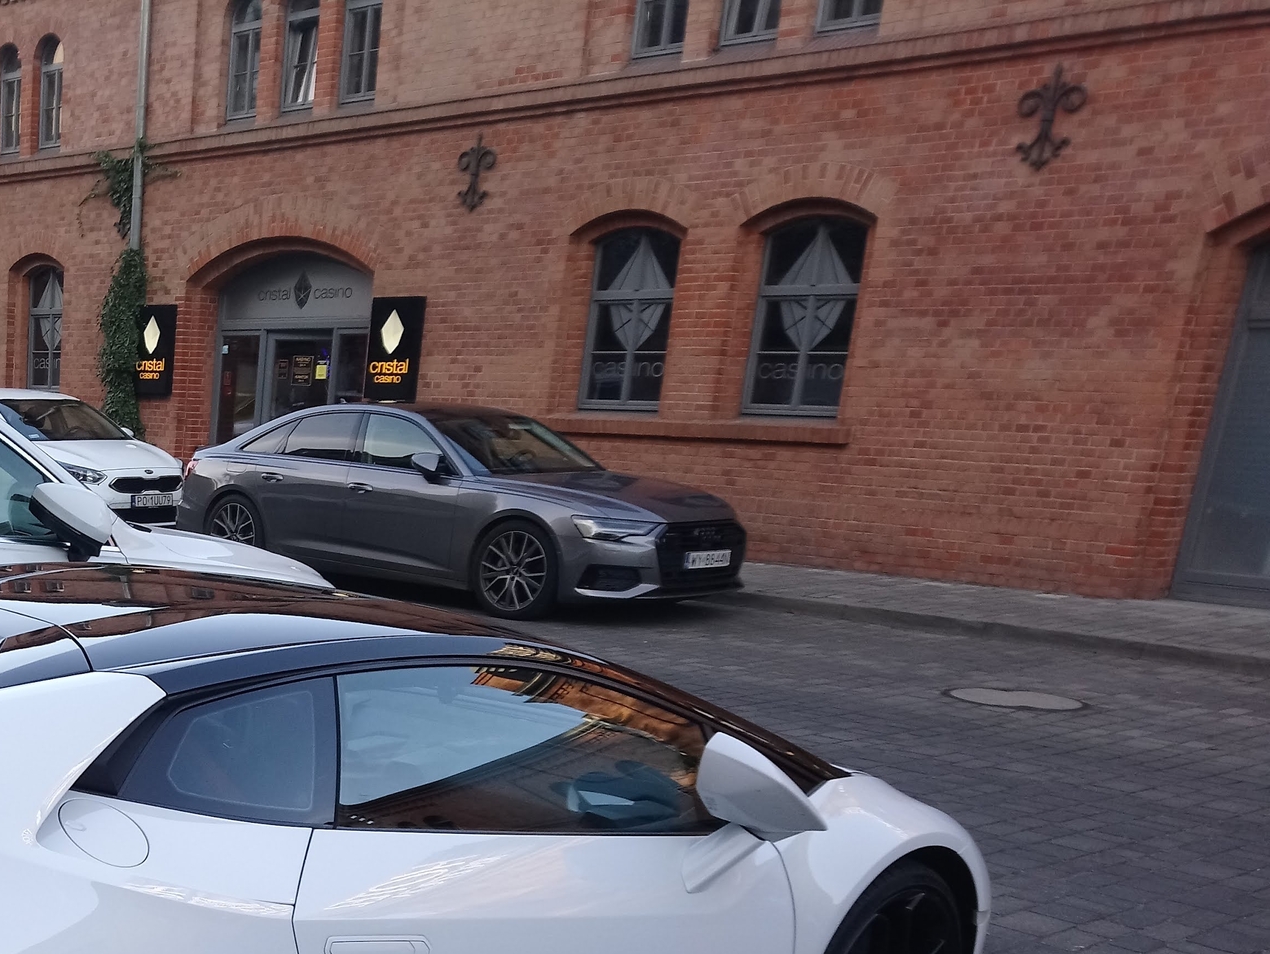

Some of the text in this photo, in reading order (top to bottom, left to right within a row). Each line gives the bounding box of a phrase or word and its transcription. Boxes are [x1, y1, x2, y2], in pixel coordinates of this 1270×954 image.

[314, 287, 353, 300] casino
[135, 357, 165, 371] cristal
[369, 358, 409, 374] cristal
[139, 372, 160, 380] casino
[374, 375, 402, 384] casino
